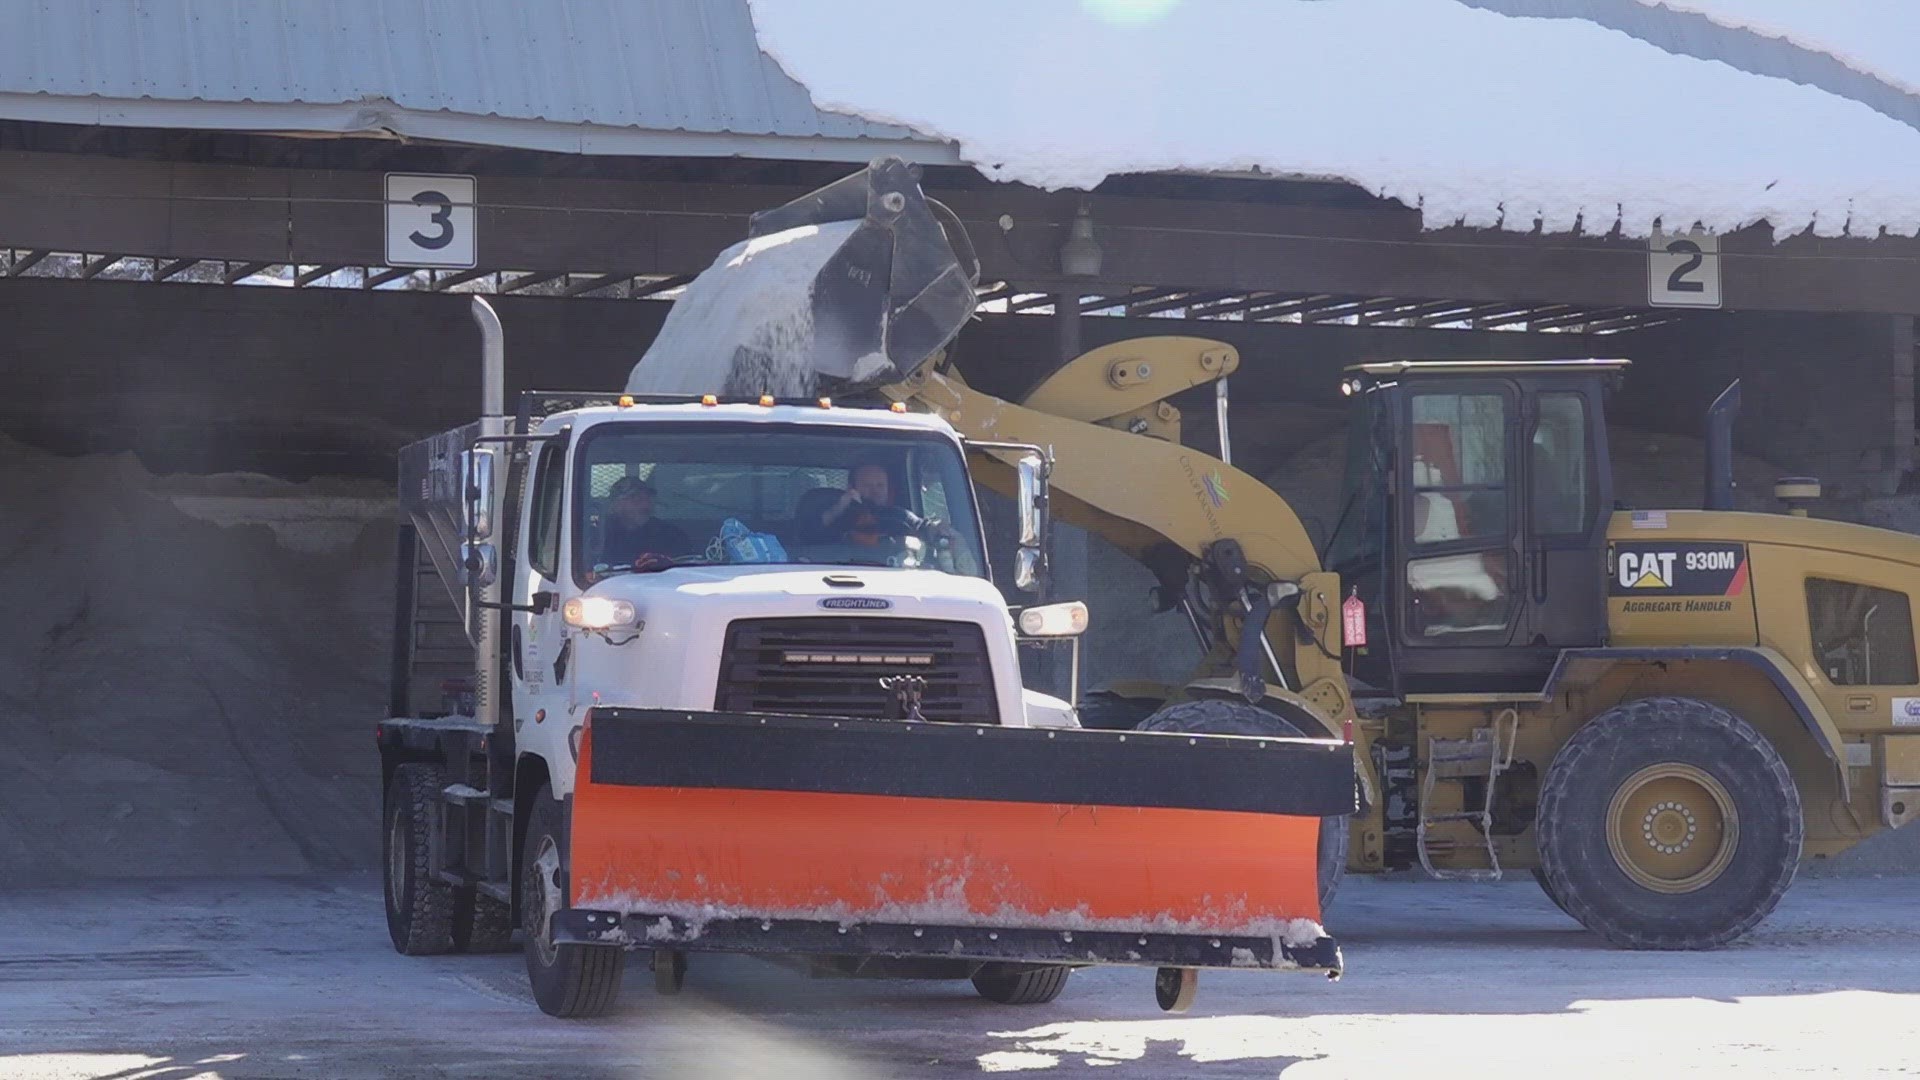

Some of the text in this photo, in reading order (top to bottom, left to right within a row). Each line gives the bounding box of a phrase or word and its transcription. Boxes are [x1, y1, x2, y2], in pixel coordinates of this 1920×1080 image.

[409, 190, 454, 250] 3
[1666, 239, 1704, 292] 2
[1618, 552, 1735, 588] CAT 930M
[826, 599, 886, 608] FREIGHTLINER
[1623, 600, 1732, 613] AGGREGATE HANDLER
